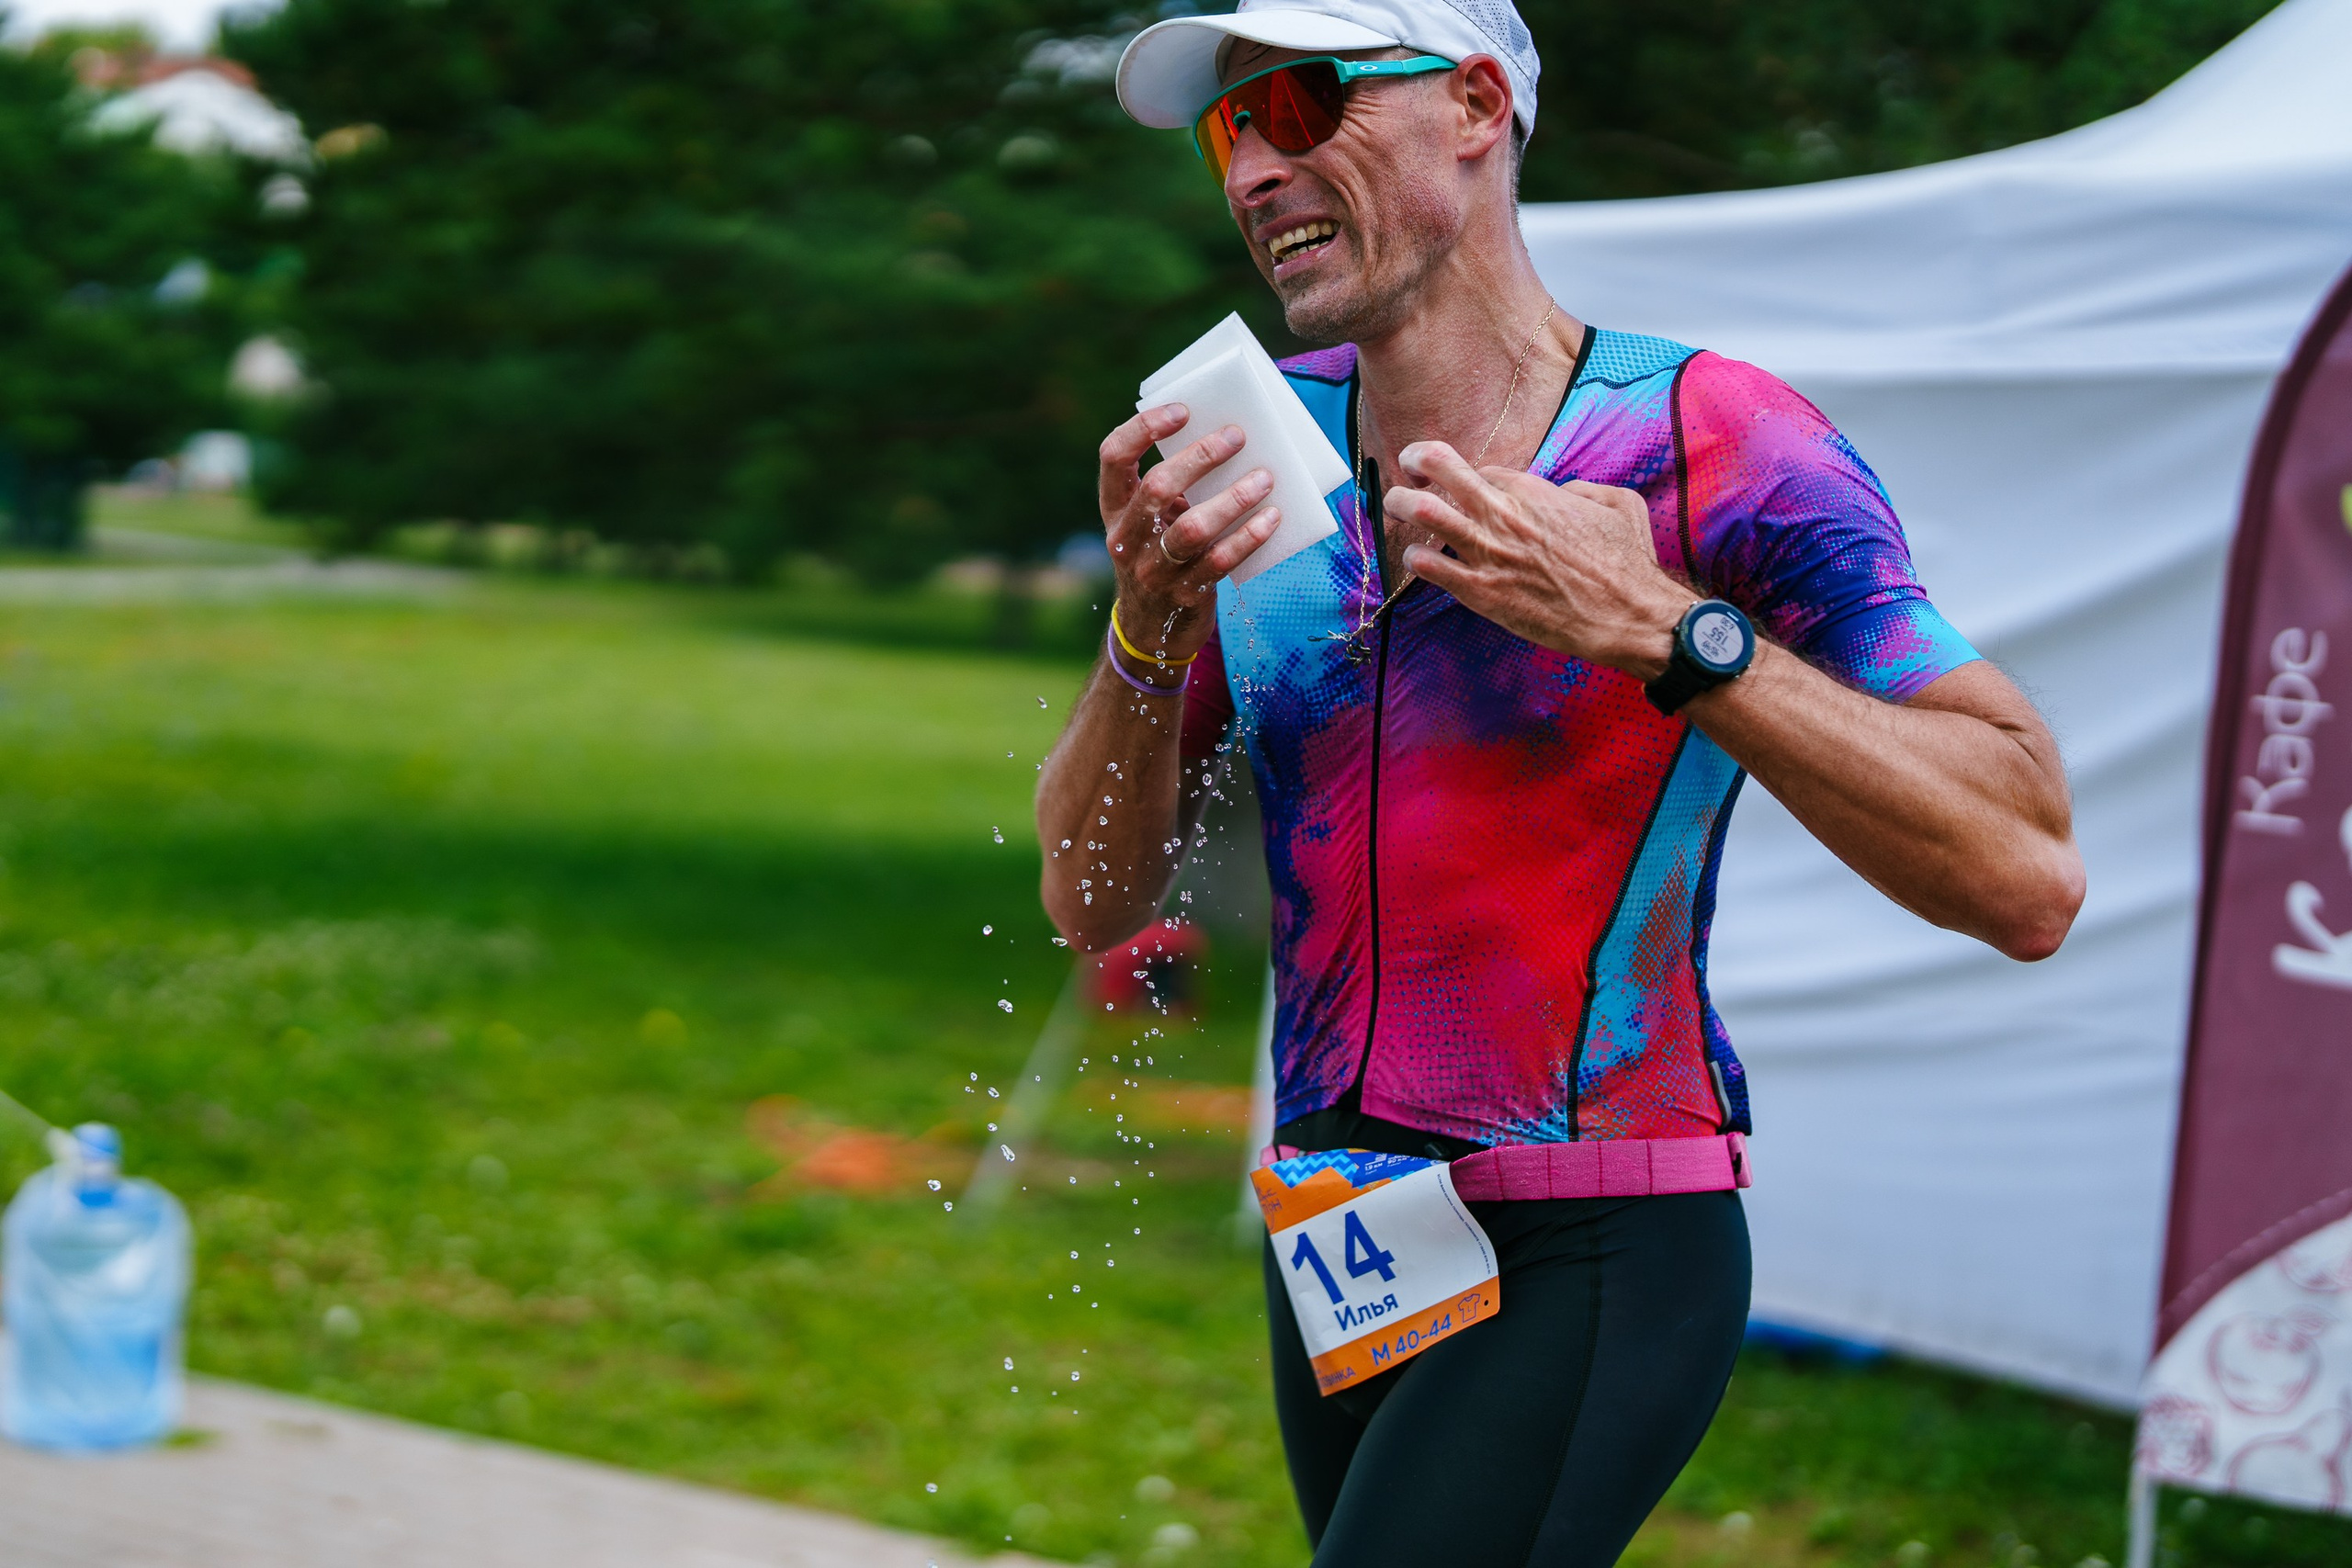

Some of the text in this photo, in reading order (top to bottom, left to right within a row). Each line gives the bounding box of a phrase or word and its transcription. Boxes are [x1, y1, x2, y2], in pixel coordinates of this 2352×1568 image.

[2233, 626, 2334, 835] Кафе
[1291, 1210, 1396, 1305] 14
[1334, 1293, 1399, 1331] Илья
[1395, 1313, 1453, 1355] 40-44
